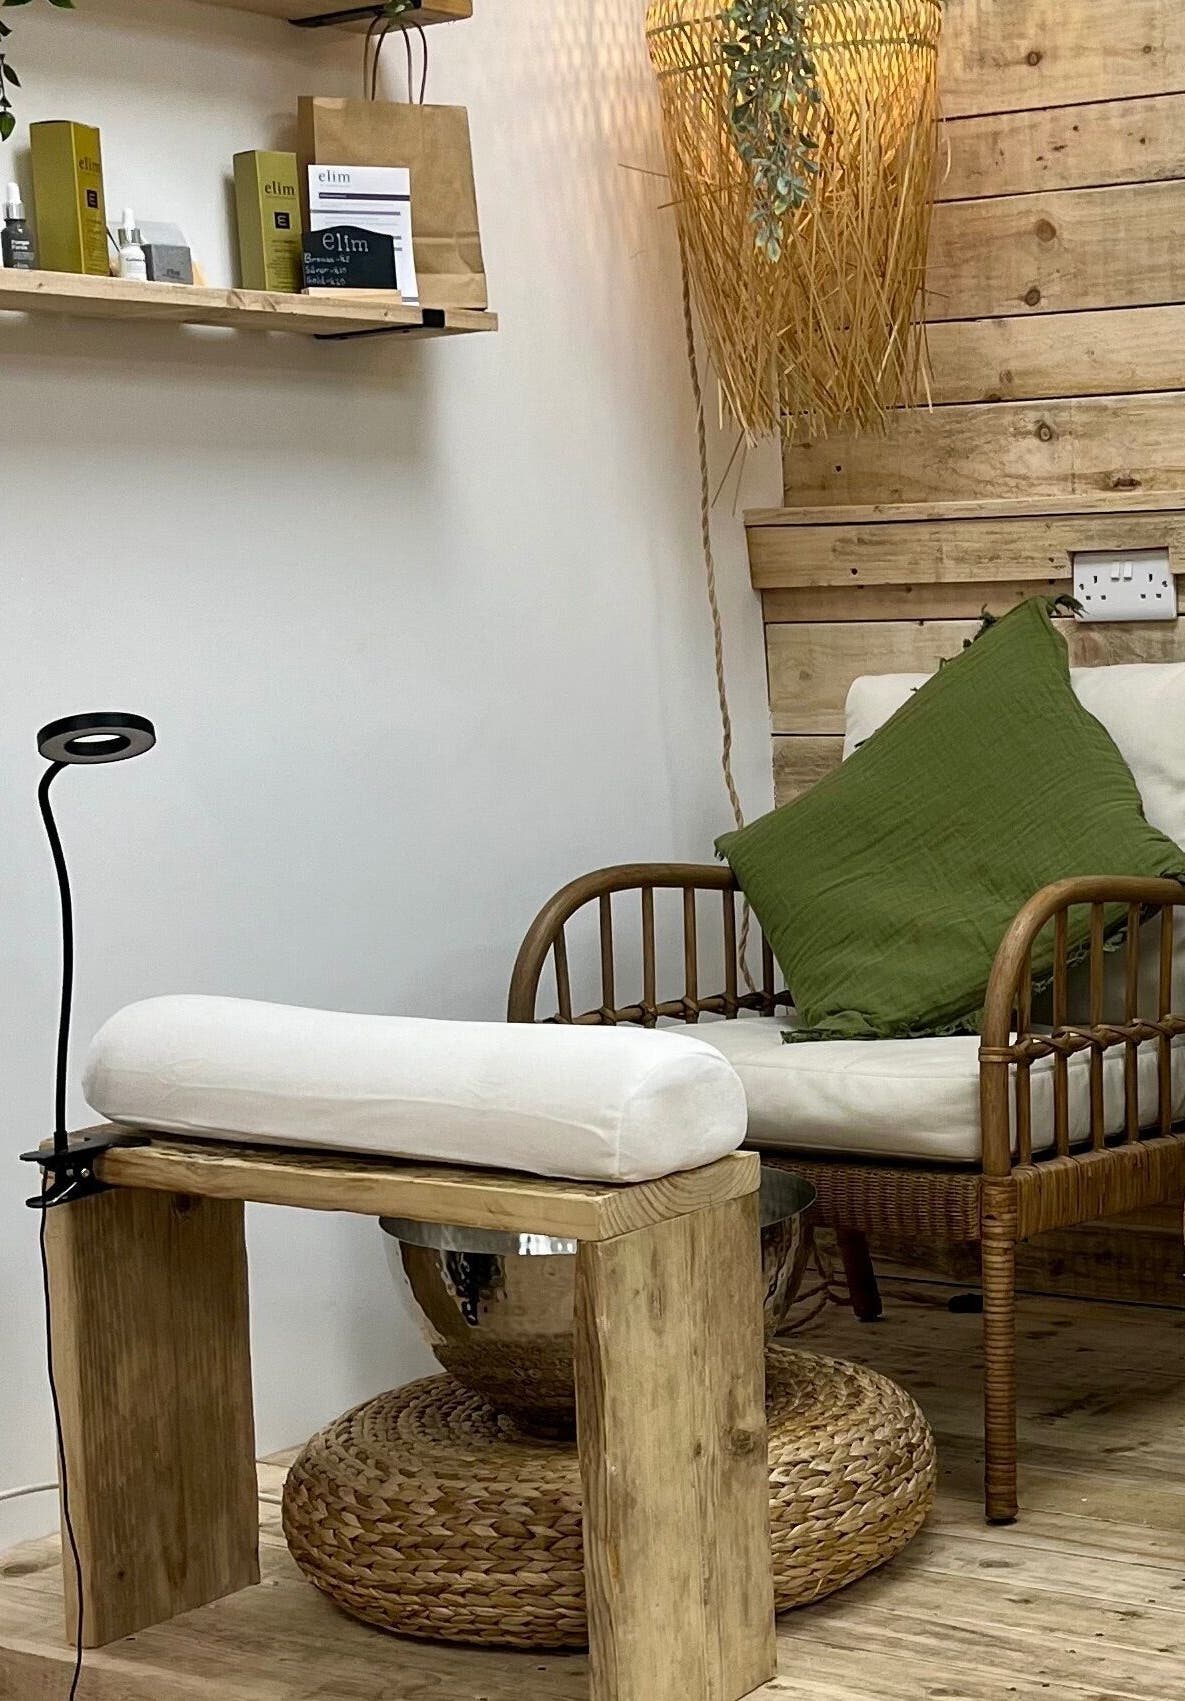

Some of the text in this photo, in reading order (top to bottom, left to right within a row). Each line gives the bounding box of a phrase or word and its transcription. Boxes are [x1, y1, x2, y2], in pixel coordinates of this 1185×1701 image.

[318, 170, 350, 183] elim
[265, 181, 295, 196] elim
[322, 233, 369, 252] elim
